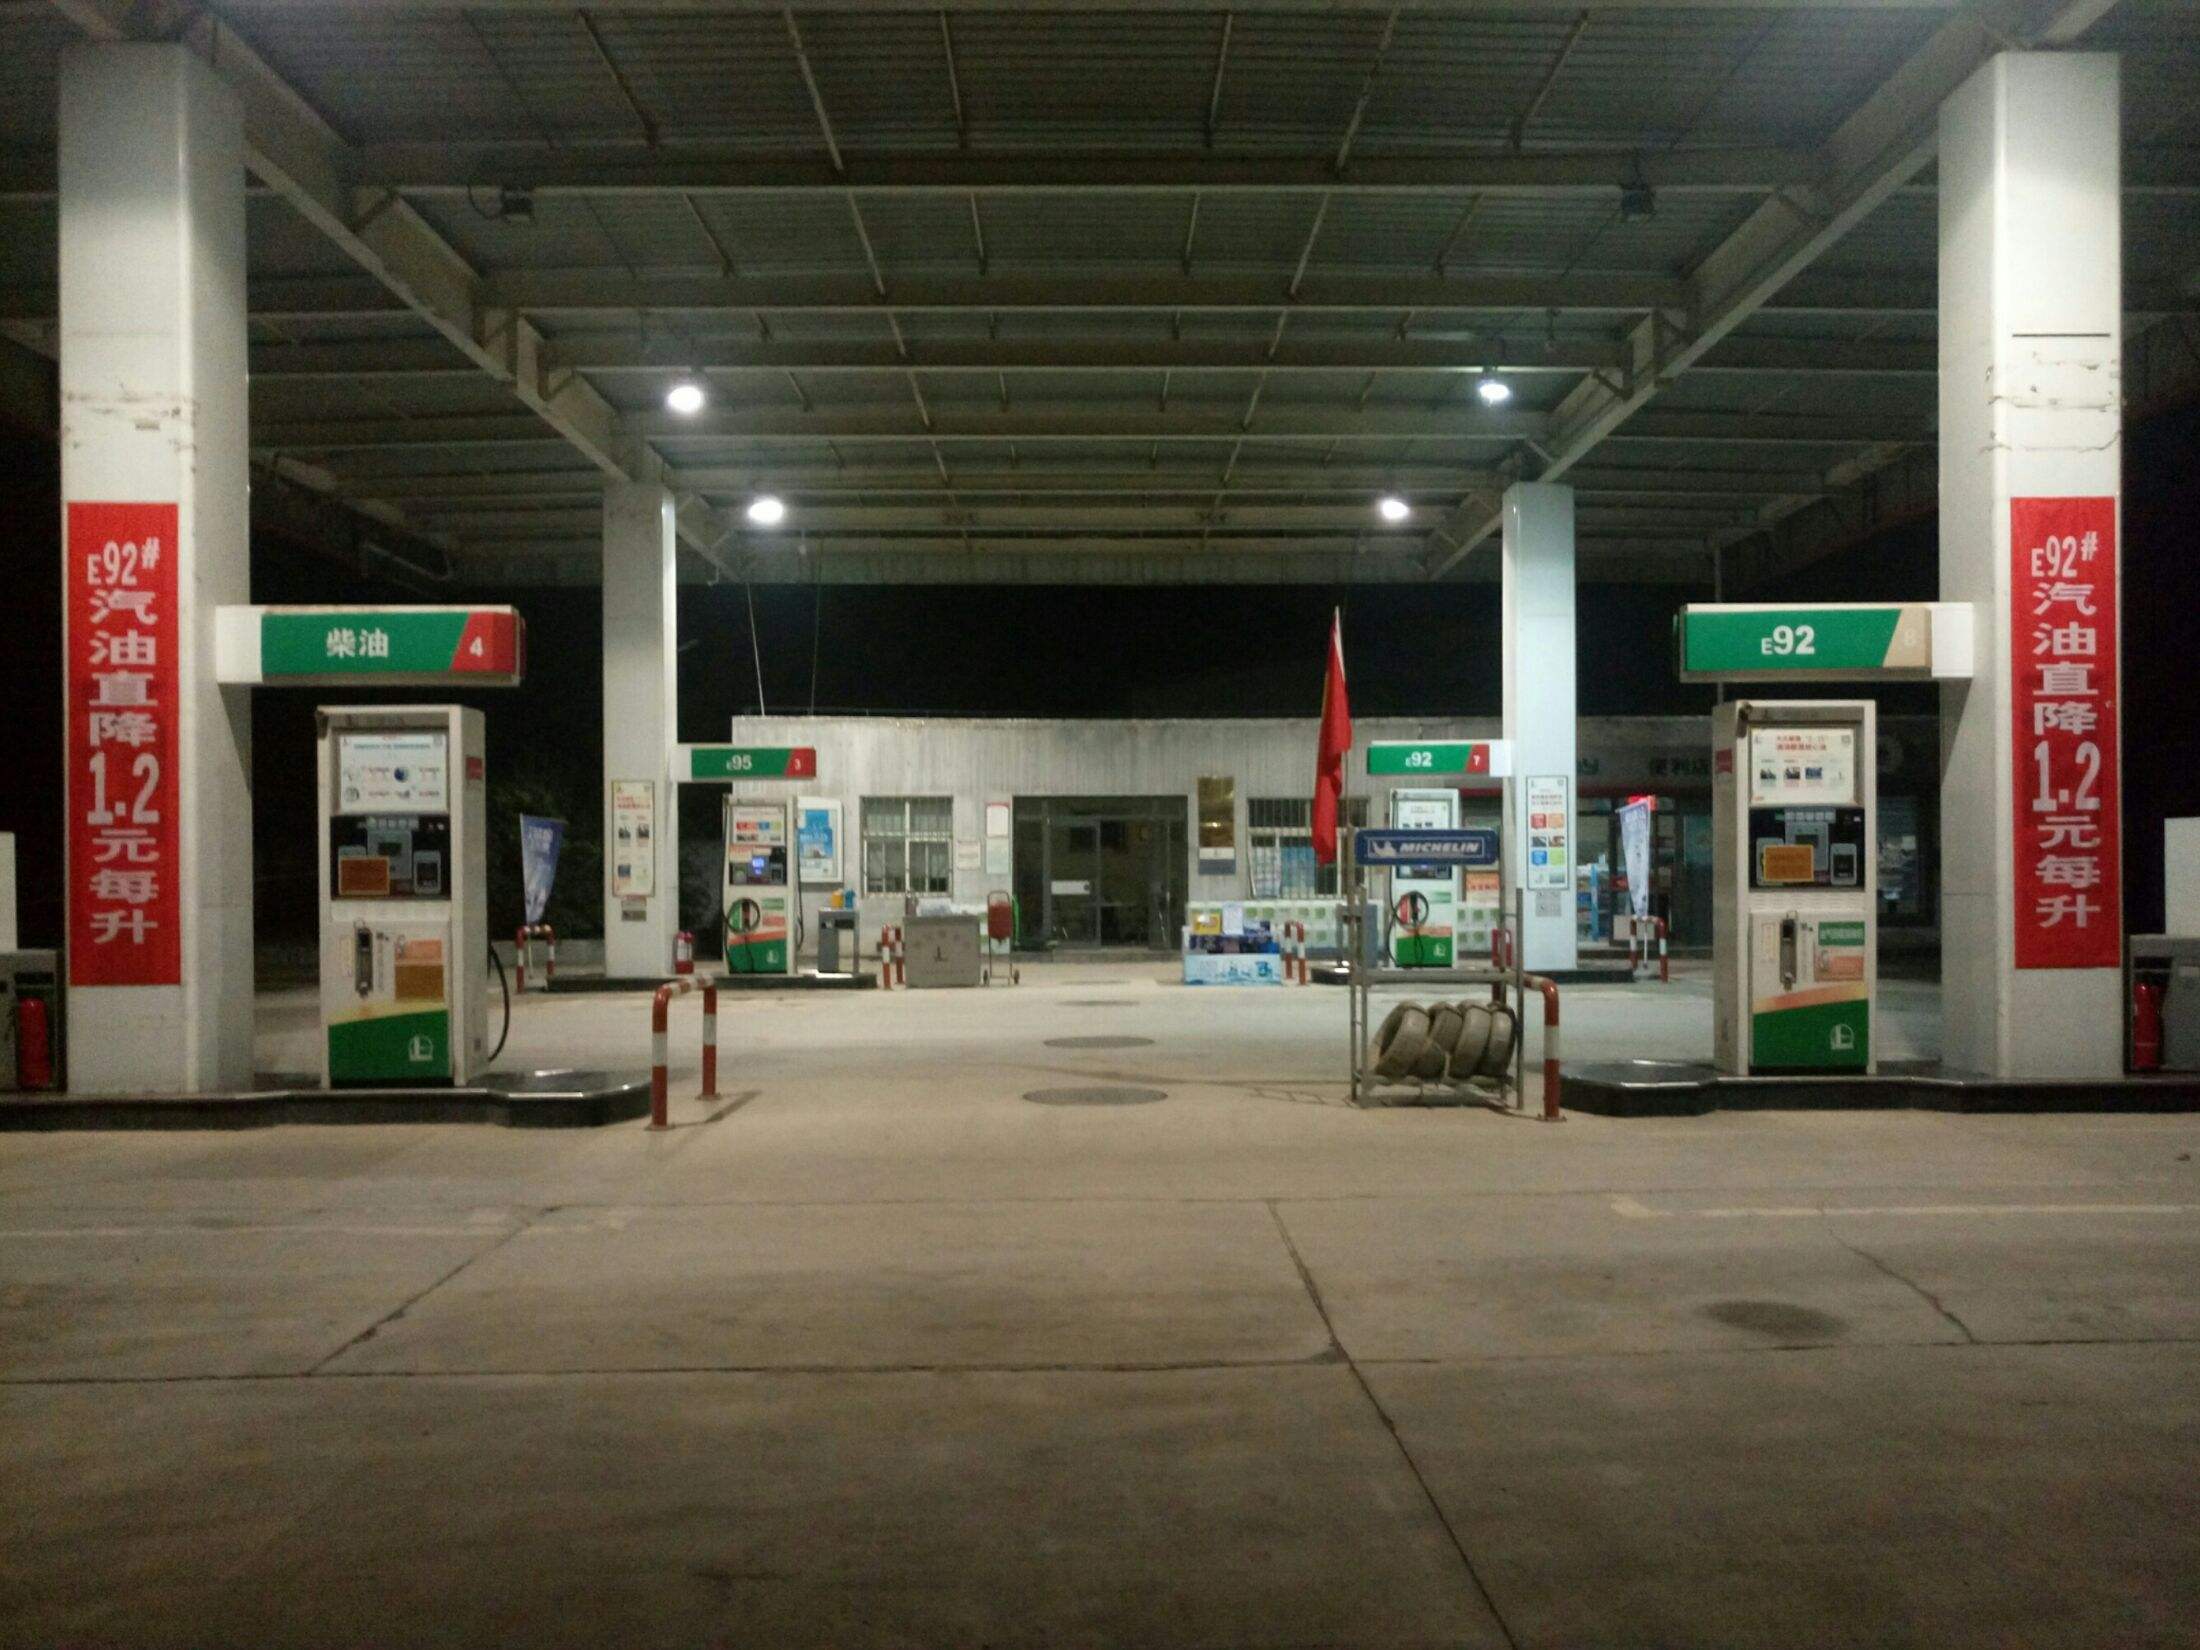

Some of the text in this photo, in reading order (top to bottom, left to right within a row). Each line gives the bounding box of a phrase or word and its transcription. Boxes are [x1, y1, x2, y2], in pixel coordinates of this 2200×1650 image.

[326, 627, 390, 658] 柴油
[469, 637, 485, 657] 4
[1760, 625, 1816, 655] E92
[1399, 842, 1480, 854] MICHELIN
